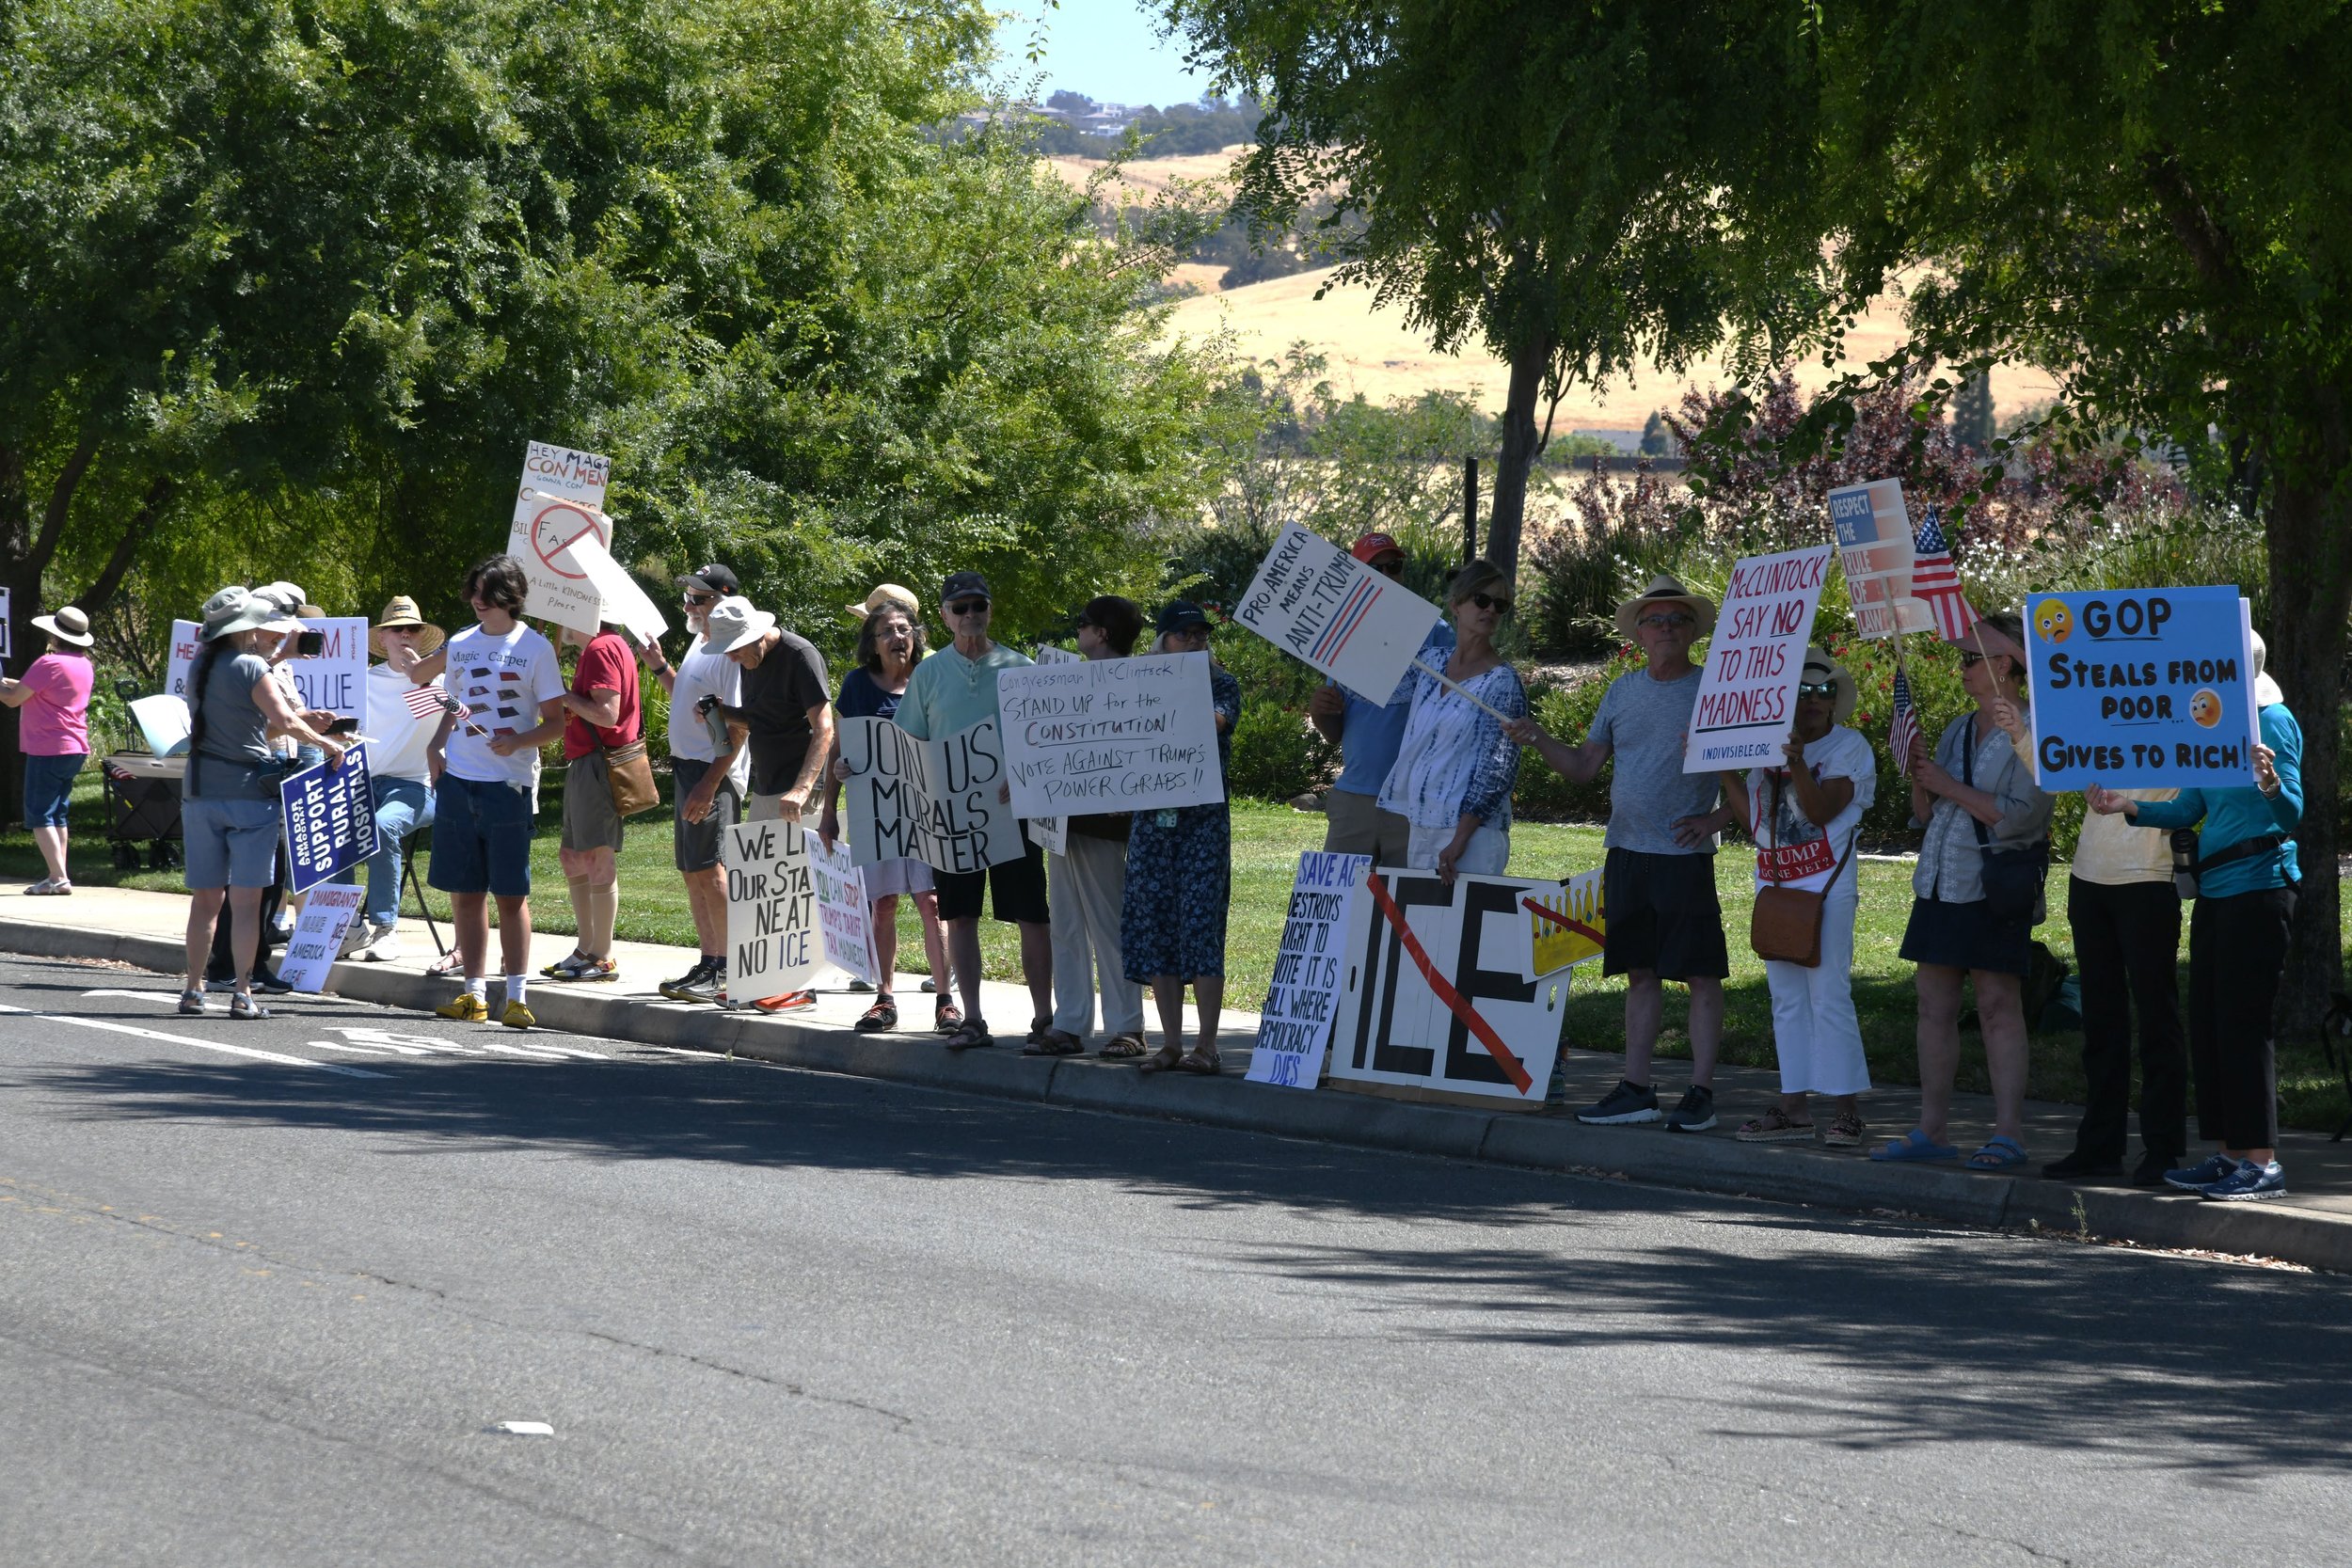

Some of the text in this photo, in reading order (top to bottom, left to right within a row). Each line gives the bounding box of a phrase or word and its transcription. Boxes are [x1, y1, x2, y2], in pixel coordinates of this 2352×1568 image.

[527, 456, 608, 487] CON MEN
[530, 444, 611, 470] HEY MAGA
[1833, 495, 1869, 518] RESPECT
[1837, 522, 1856, 542] THE
[1243, 531, 1309, 626] PRO-AMERICA
[1844, 550, 1872, 576] RULE
[548, 597, 577, 611] Please
[562, 587, 601, 606] KINDNESS
[1279, 565, 1314, 613] MEANS
[1285, 550, 1357, 655] ANTI-TRUMP
[1851, 581, 1867, 604] OF
[1728, 599, 1804, 640] SAY NO
[1858, 609, 1883, 633] LAW
[2083, 597, 2171, 638] GOP
[453, 651, 527, 668] Magic Carpet
[1718, 643, 1786, 683] TO THIS
[2168, 658, 2237, 684] FROM
[294, 673, 355, 710] BLUE
[999, 673, 1083, 699] Congressman
[1003, 692, 1162, 721] STAND UP for the
[1697, 686, 1787, 726] MADNESS
[844, 720, 998, 794] JOIN US
[1702, 743, 1771, 761] INDIVISIBLE.ORG
[2040, 735, 2248, 772] GIVES TO RICH!
[1011, 758, 1055, 787] VOTE
[345, 750, 374, 855] HOSPITALS
[871, 777, 990, 836] MORALS
[1043, 776, 1116, 804] POWER
[305, 778, 333, 872] SUPPORT
[328, 777, 352, 848] RURAL
[291, 800, 307, 866] AMADOR
[297, 798, 311, 865] DEMOCRATS
[735, 825, 775, 862] WE
[874, 817, 991, 873] MATTER
[729, 869, 767, 902] OUR
[1298, 852, 1337, 886] SAVE
[310, 891, 361, 908] IMMIGRANTS
[814, 868, 859, 910] YOU CAN STOP
[755, 892, 815, 937] NEAT
[1287, 893, 1343, 921] DESTROYS
[843, 912, 861, 938] TARIFF
[1279, 920, 1329, 953] RIGHT TO
[290, 942, 326, 960] AMERICA
[739, 930, 810, 978] NO ICE
[825, 931, 838, 957] TAX
[1272, 952, 1337, 989] VOTE IT IS
[1352, 875, 1538, 1085] ICE
[1291, 989, 1331, 1022] WHERE
[1255, 1020, 1319, 1054] DEMOCRACY
[1269, 1053, 1300, 1085] DIES
